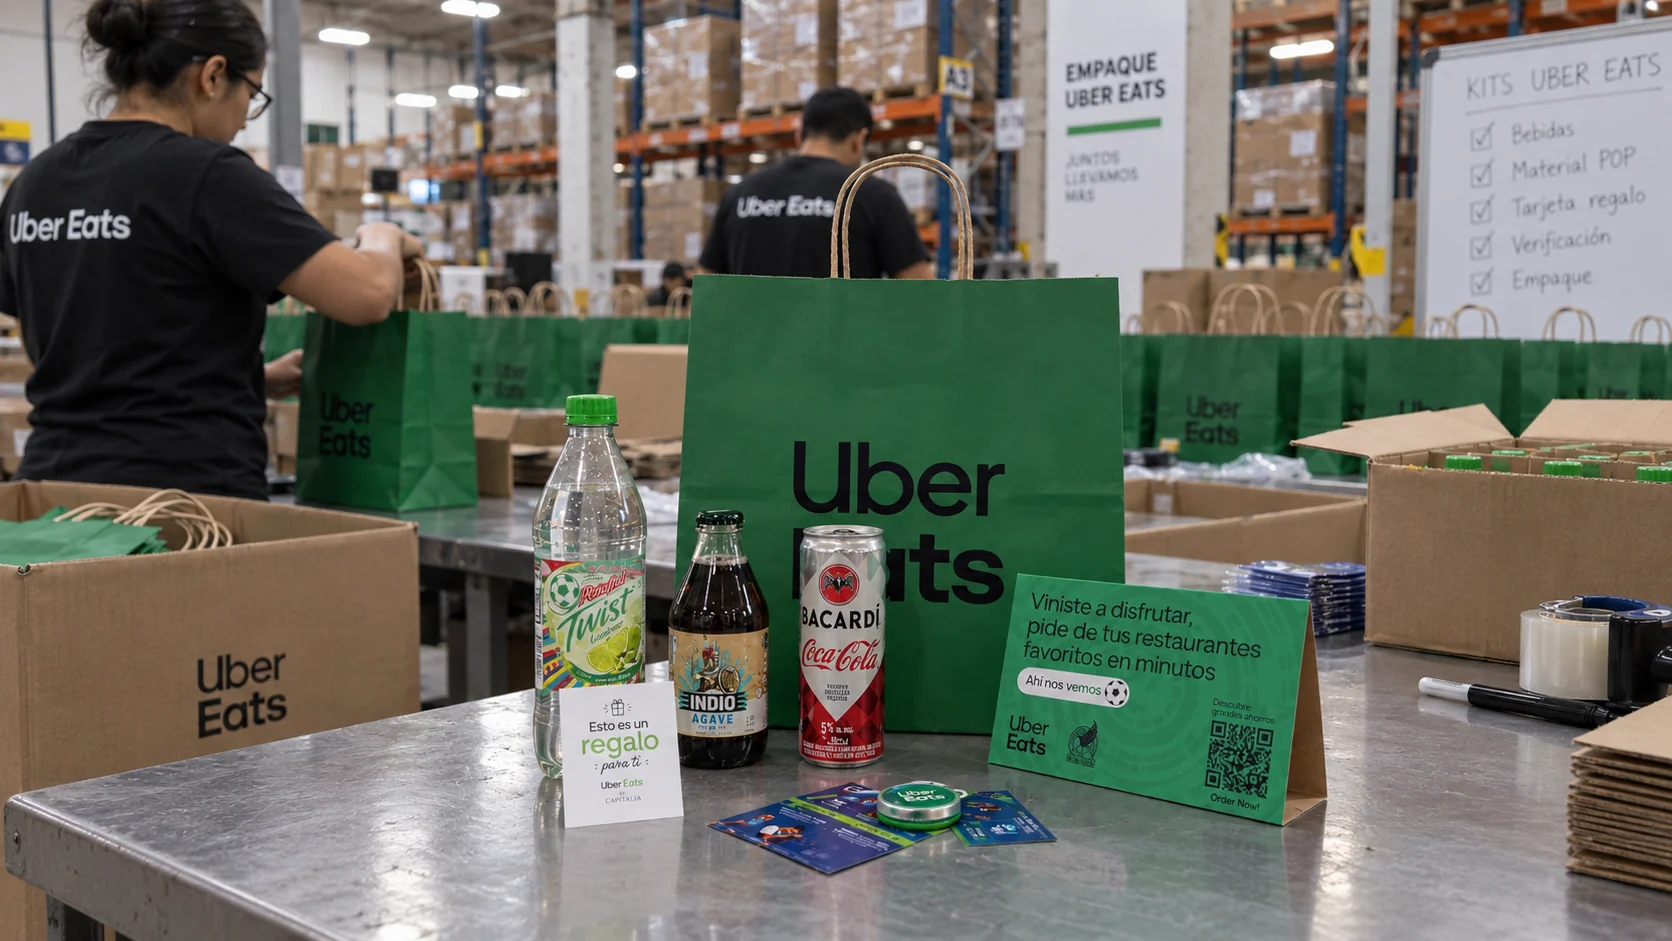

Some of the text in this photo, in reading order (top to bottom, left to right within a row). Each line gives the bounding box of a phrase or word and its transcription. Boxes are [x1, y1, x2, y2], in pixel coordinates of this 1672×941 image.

[946, 66, 969, 90] A3
[1066, 51, 1158, 82] EMPAQUE
[1467, 52, 1662, 100] KITS UBER EATS
[1066, 79, 1166, 109] UBER EATS
[1511, 118, 1576, 145] Bebidas
[1066, 150, 1120, 169] JUNTOS
[1512, 145, 1636, 181] Material POP
[1065, 167, 1139, 187] LLEVAMOS
[737, 194, 836, 218] Uber Eats
[1511, 184, 1646, 222] Tarjeta regalo
[10, 208, 131, 244] Uber Eats
[1511, 225, 1612, 257] Verificación
[1512, 268, 1594, 295] Empaque
[320, 391, 376, 424] Uber
[1186, 394, 1241, 419] Uber
[319, 425, 372, 459] Eats
[1184, 420, 1239, 447] Eats
[793, 440, 1006, 517] Uber
[557, 587, 635, 653] Twist
[802, 603, 881, 629] BACARDÍ
[1031, 592, 1194, 628] Viniste a disfrutar,
[1026, 619, 1262, 659] pide de tus restaurantes
[802, 638, 881, 672] Coca-Cola
[1023, 641, 1216, 682] favoritos en minutos
[197, 653, 287, 695] Uber
[1044, 678, 1064, 691] nos
[1066, 682, 1102, 696] vemos
[198, 691, 288, 740] Eats
[690, 694, 737, 712] INDIO
[1211, 708, 1276, 725] grandes ahorros
[1212, 697, 1252, 712] Descubre
[589, 719, 649, 733] Esto es un
[692, 713, 734, 725] AGAVE
[1009, 714, 1050, 736] Uber
[581, 731, 660, 759] regalo
[1006, 732, 1047, 756] Eats
[600, 755, 642, 775] para ti
[600, 778, 644, 790] Uber Eats
[897, 789, 937, 798] Uber
[605, 795, 642, 804] CAPITALIA
[1210, 792, 1260, 811] Order Now!
